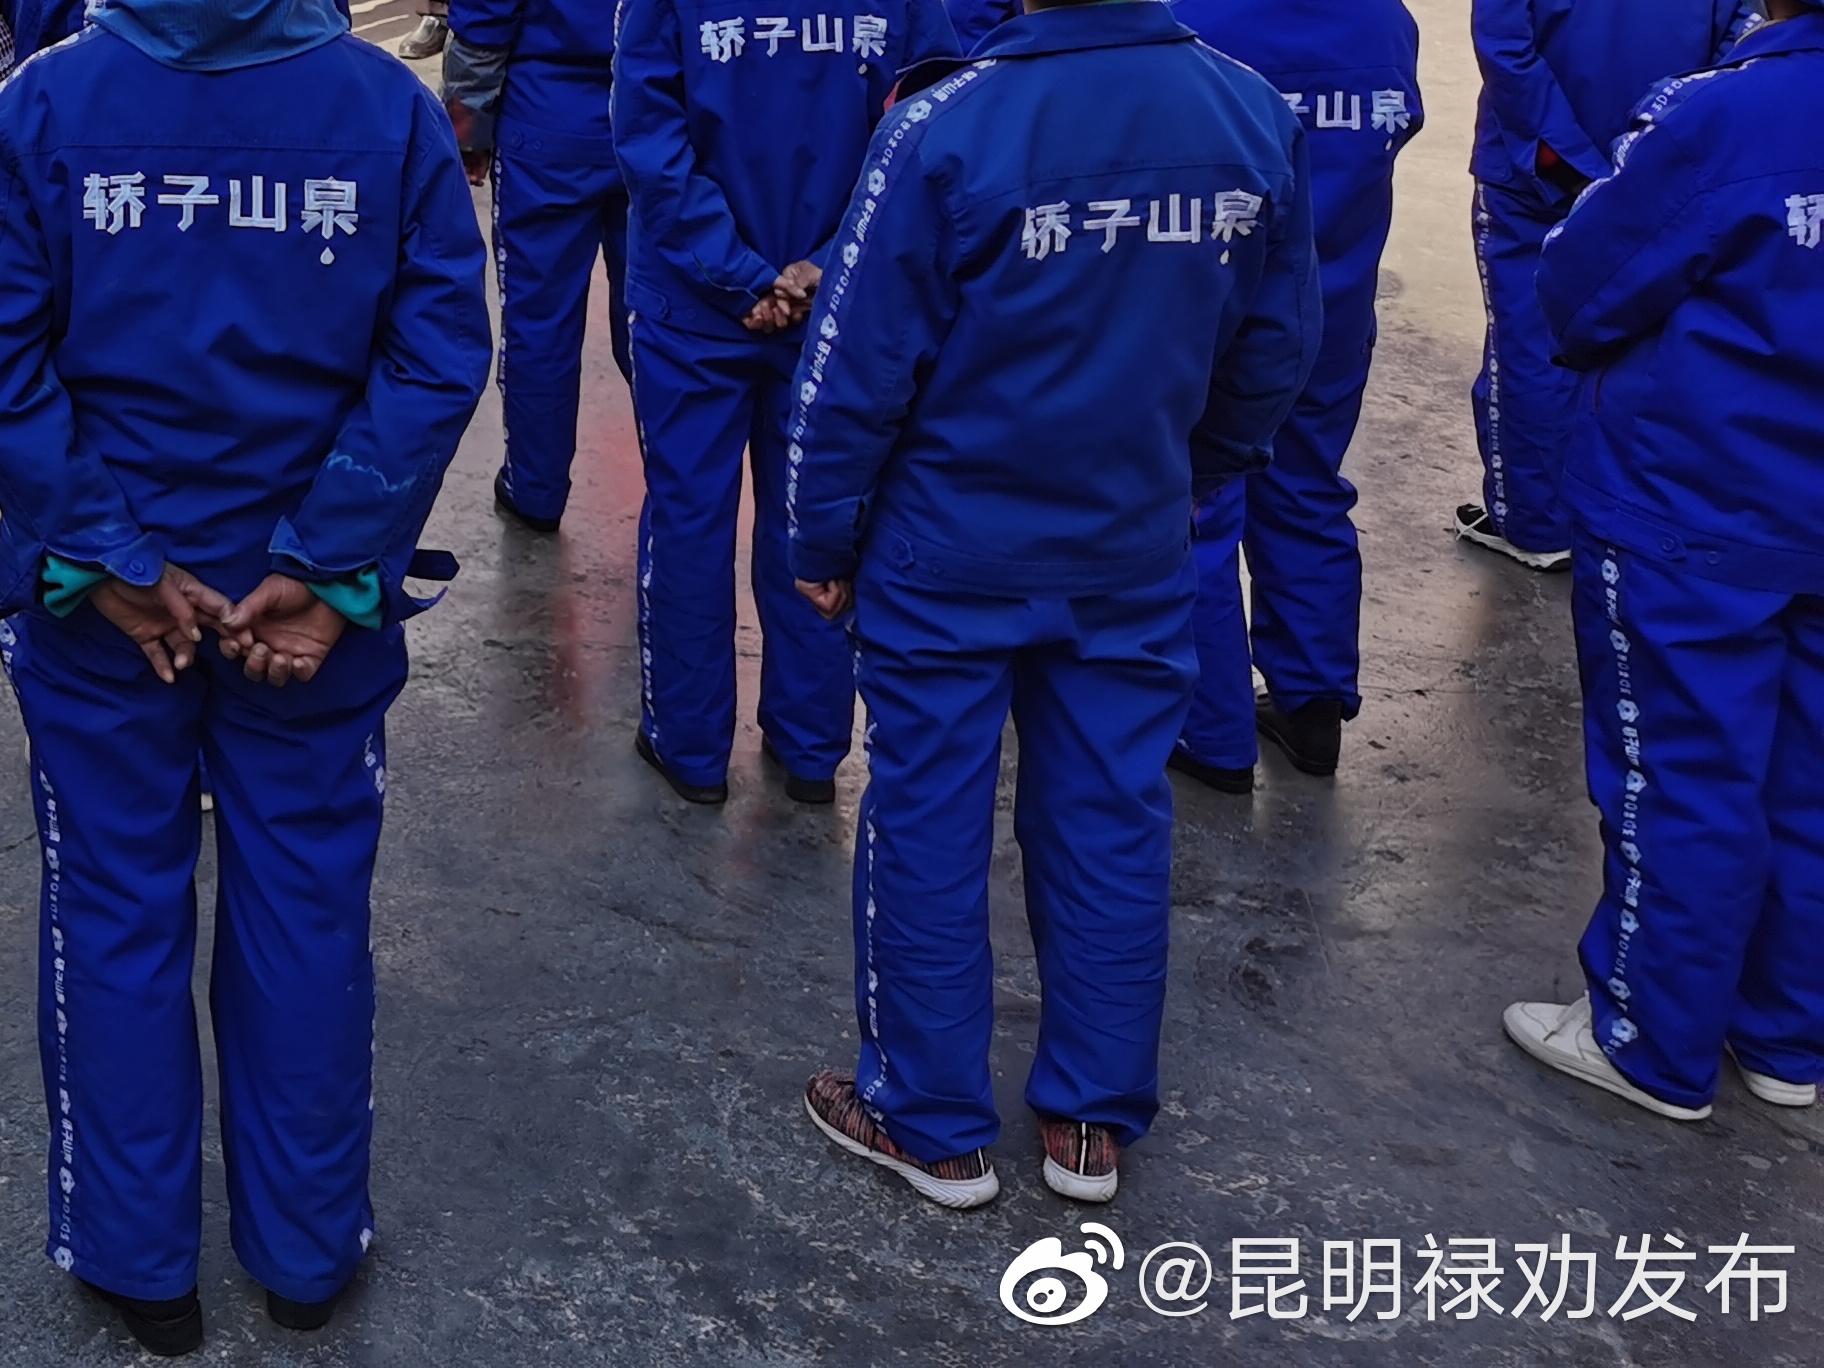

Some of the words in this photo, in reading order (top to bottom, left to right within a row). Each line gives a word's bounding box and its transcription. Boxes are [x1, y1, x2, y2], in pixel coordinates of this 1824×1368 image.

[699, 14, 888, 64] 轿子山泉
[82, 171, 360, 239] 轿子山泉
[1020, 188, 1262, 261] 轿子山泉
